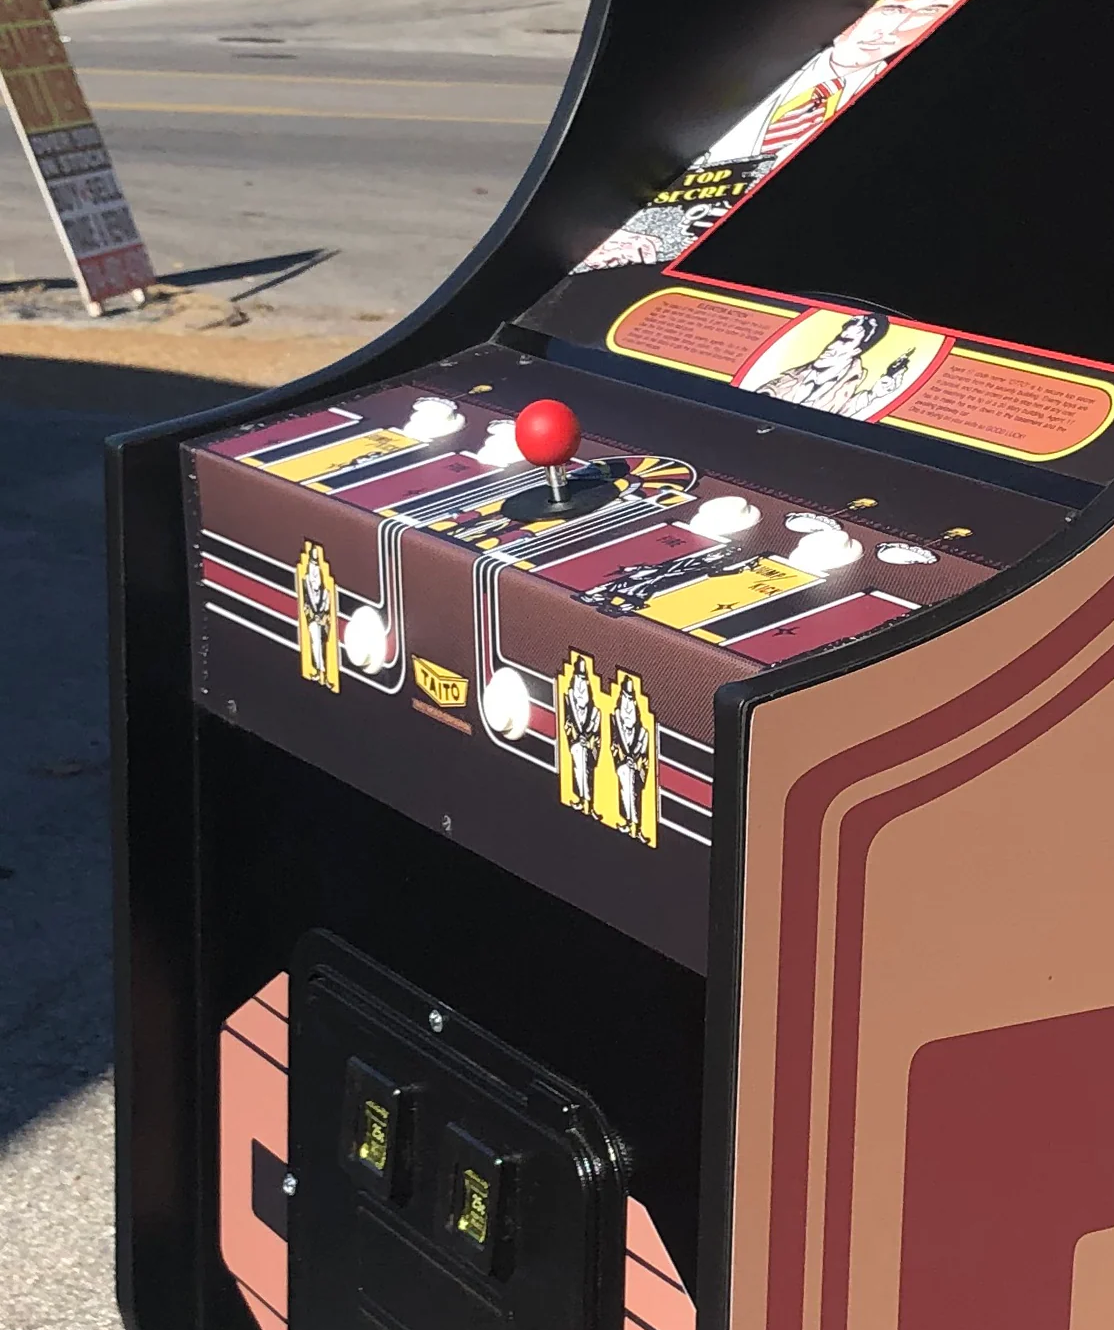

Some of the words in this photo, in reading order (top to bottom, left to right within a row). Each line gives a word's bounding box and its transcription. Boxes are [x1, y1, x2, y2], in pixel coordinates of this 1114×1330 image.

[683, 169, 732, 186] TOP
[653, 183, 748, 203] SECRET
[420, 669, 460, 701] TAITO
